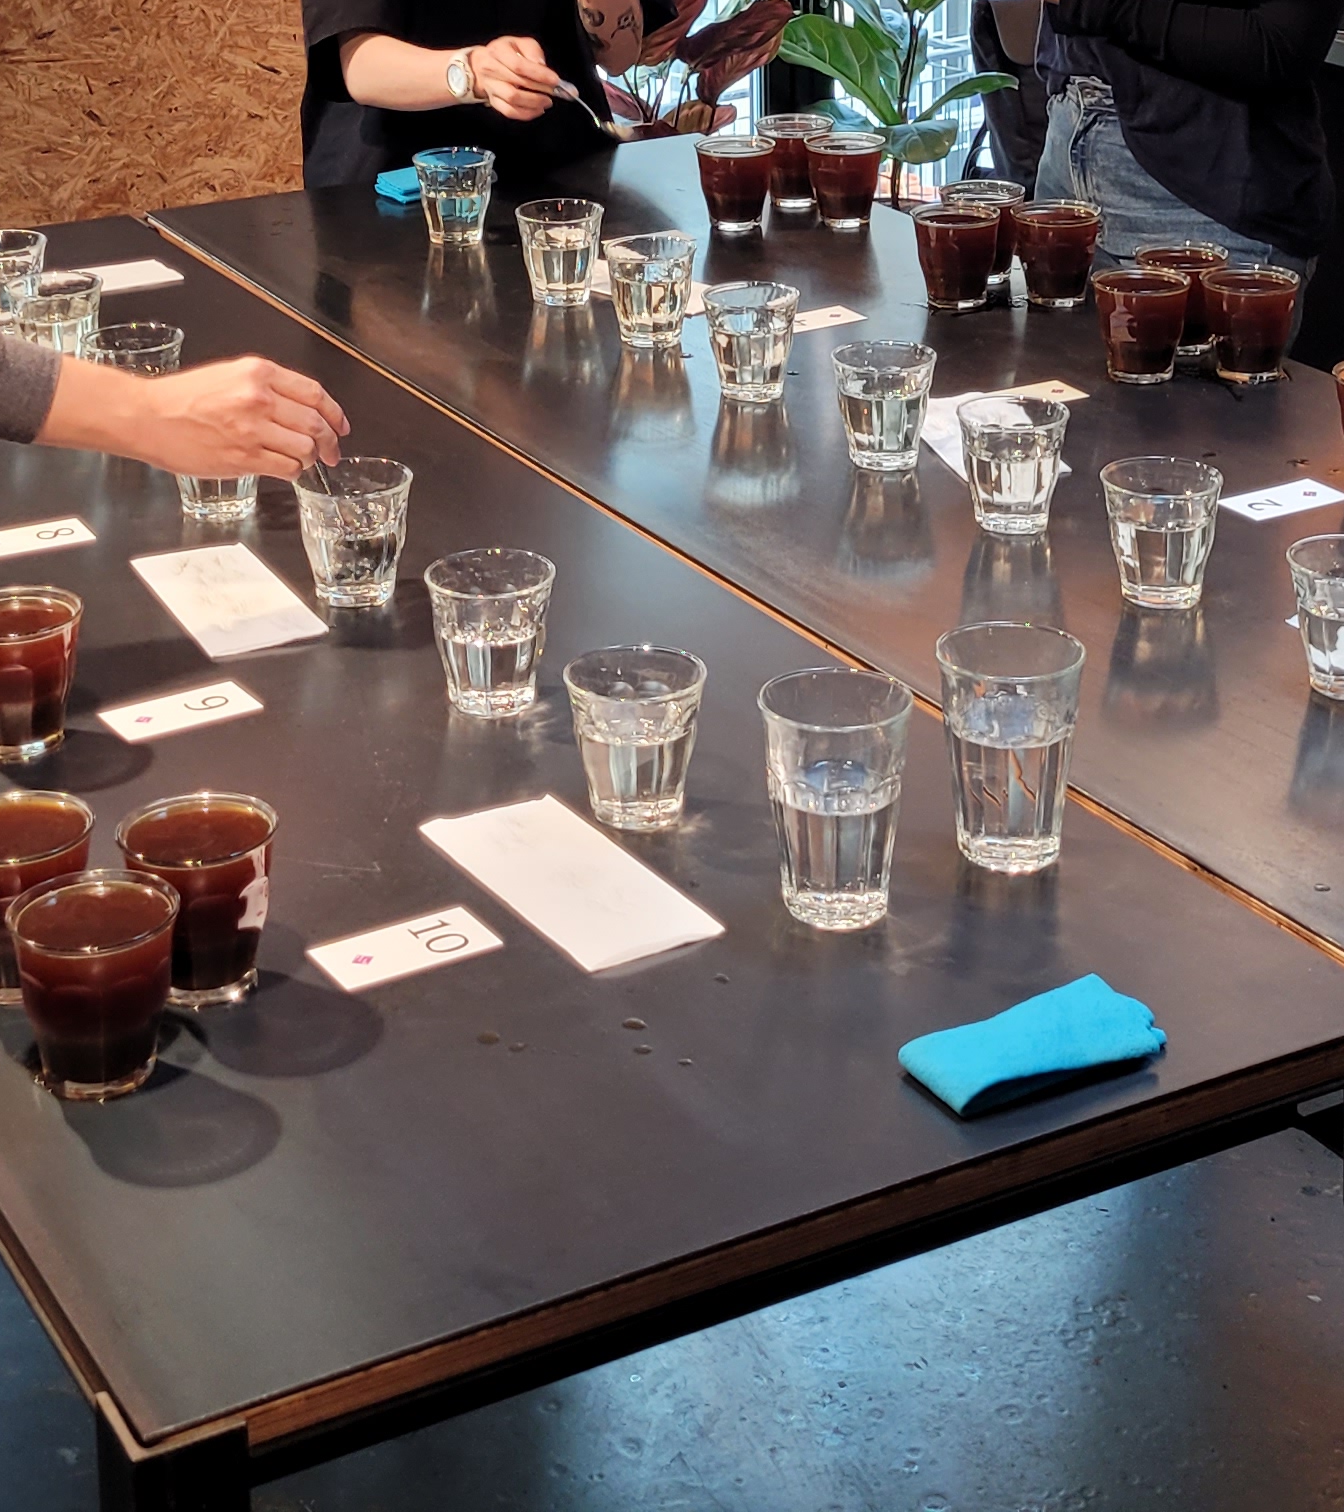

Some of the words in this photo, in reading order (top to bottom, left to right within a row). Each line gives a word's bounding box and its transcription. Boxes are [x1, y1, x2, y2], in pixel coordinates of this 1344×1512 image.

[1247, 498, 1283, 511] 2
[36, 527, 75, 540] 8
[184, 695, 230, 711] 9
[407, 919, 470, 954] 10
